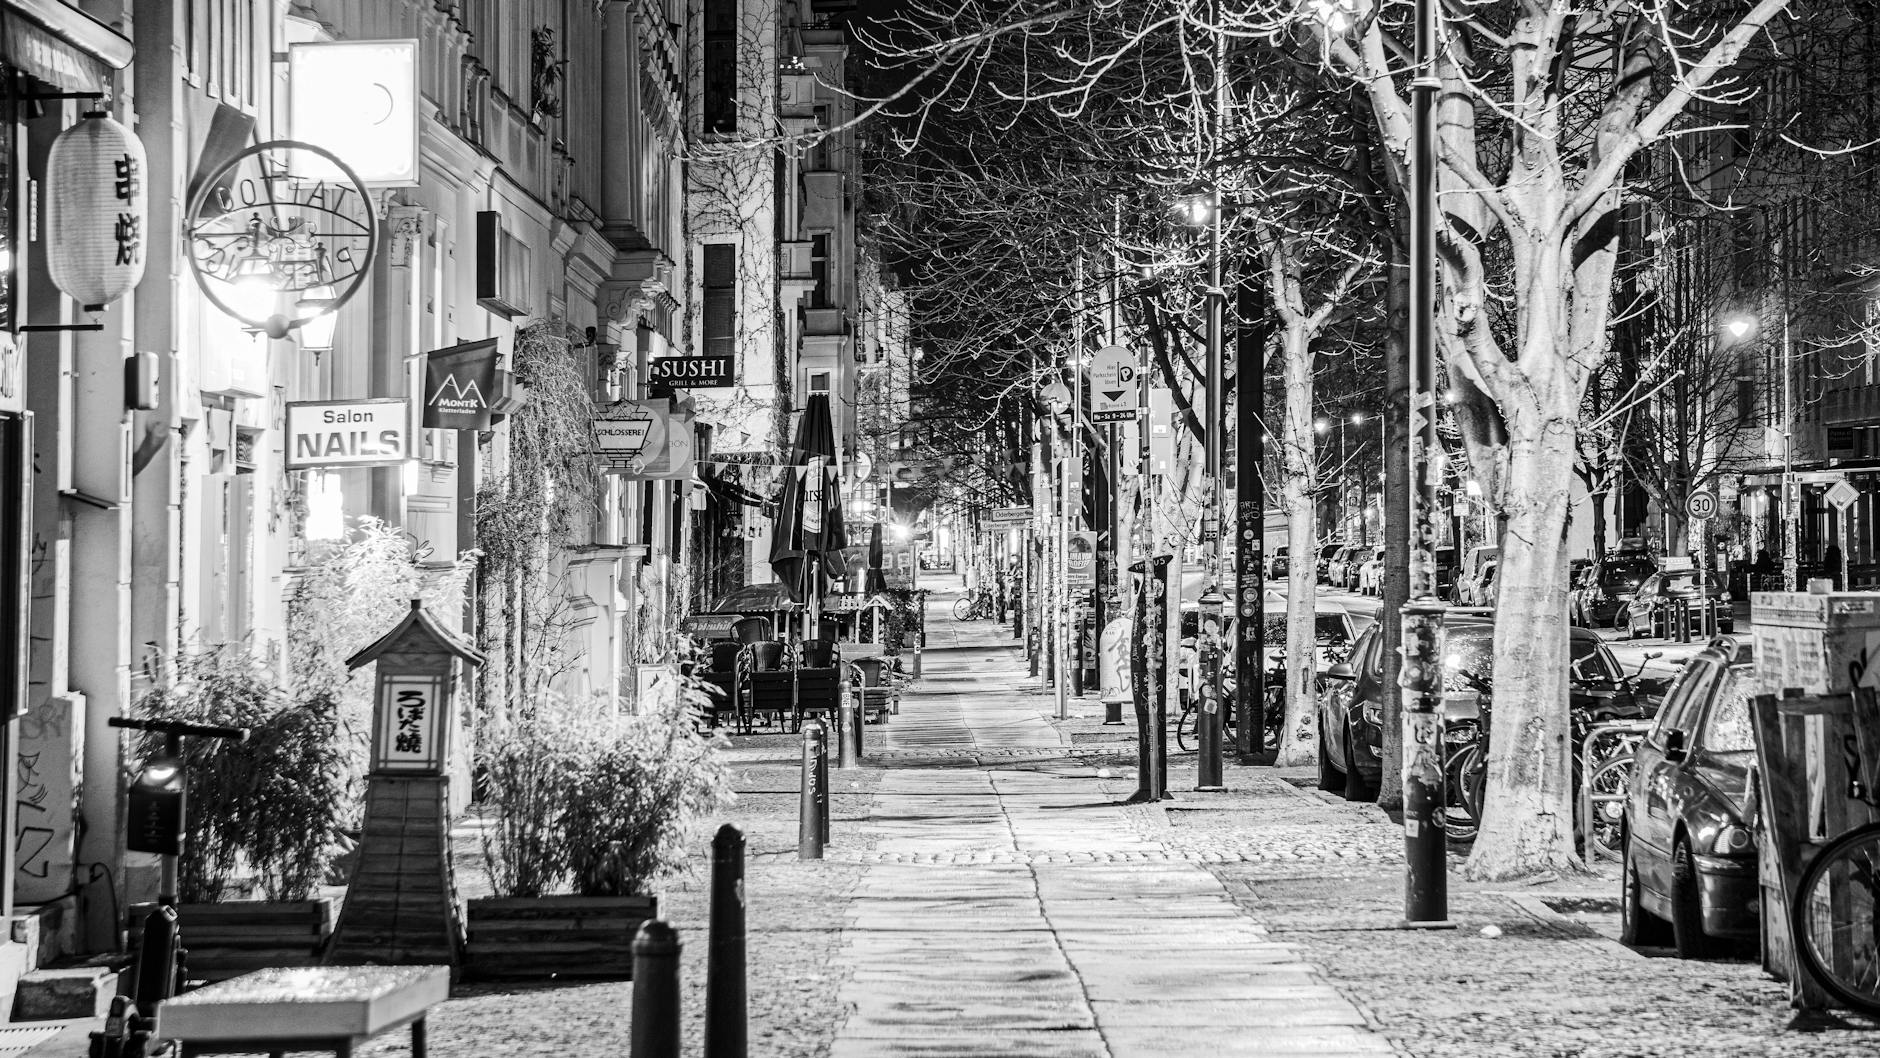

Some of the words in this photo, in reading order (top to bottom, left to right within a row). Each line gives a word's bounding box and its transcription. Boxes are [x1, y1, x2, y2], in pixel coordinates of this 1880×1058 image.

[660, 359, 727, 378] SUSHI
[668, 379, 688, 387] GRILL
[323, 409, 374, 424] Salon
[438, 407, 477, 415] Kletterladen
[598, 428, 645, 437] SCHLOSSEREI
[296, 430, 400, 459] NAILS
[1692, 499, 1710, 512] 30
[996, 511, 1025, 519] Oderberger
